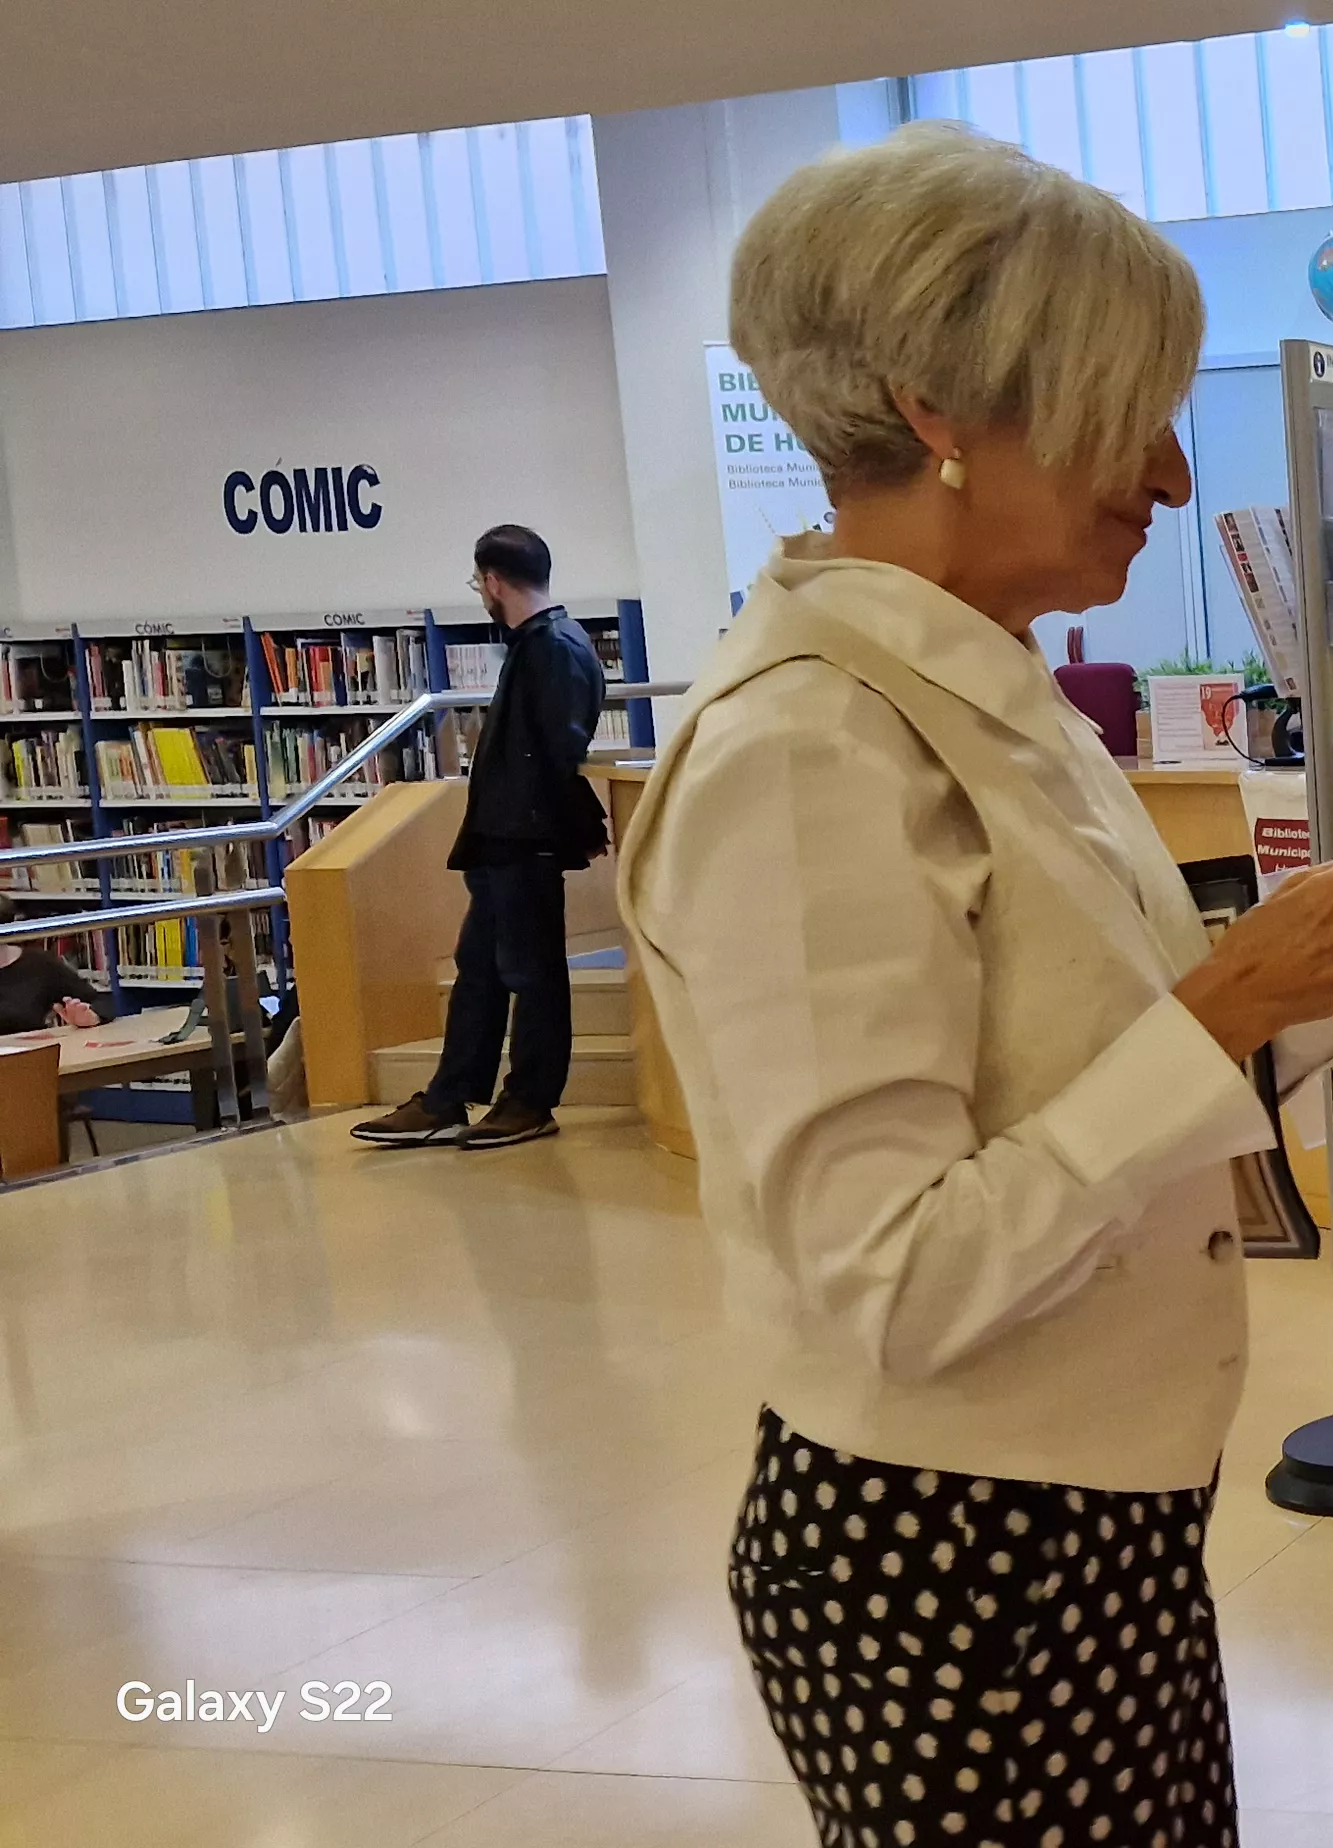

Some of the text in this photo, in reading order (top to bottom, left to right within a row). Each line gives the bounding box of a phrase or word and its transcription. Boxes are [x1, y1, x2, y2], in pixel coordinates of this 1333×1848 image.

[725, 433, 764, 453] DE
[727, 463, 784, 474] Biblioteca
[728, 478, 785, 490] Biblioteca
[223, 457, 383, 534] CÓMIC
[1200, 686, 1212, 700] 19
[1262, 827, 1310, 839] Bibliote
